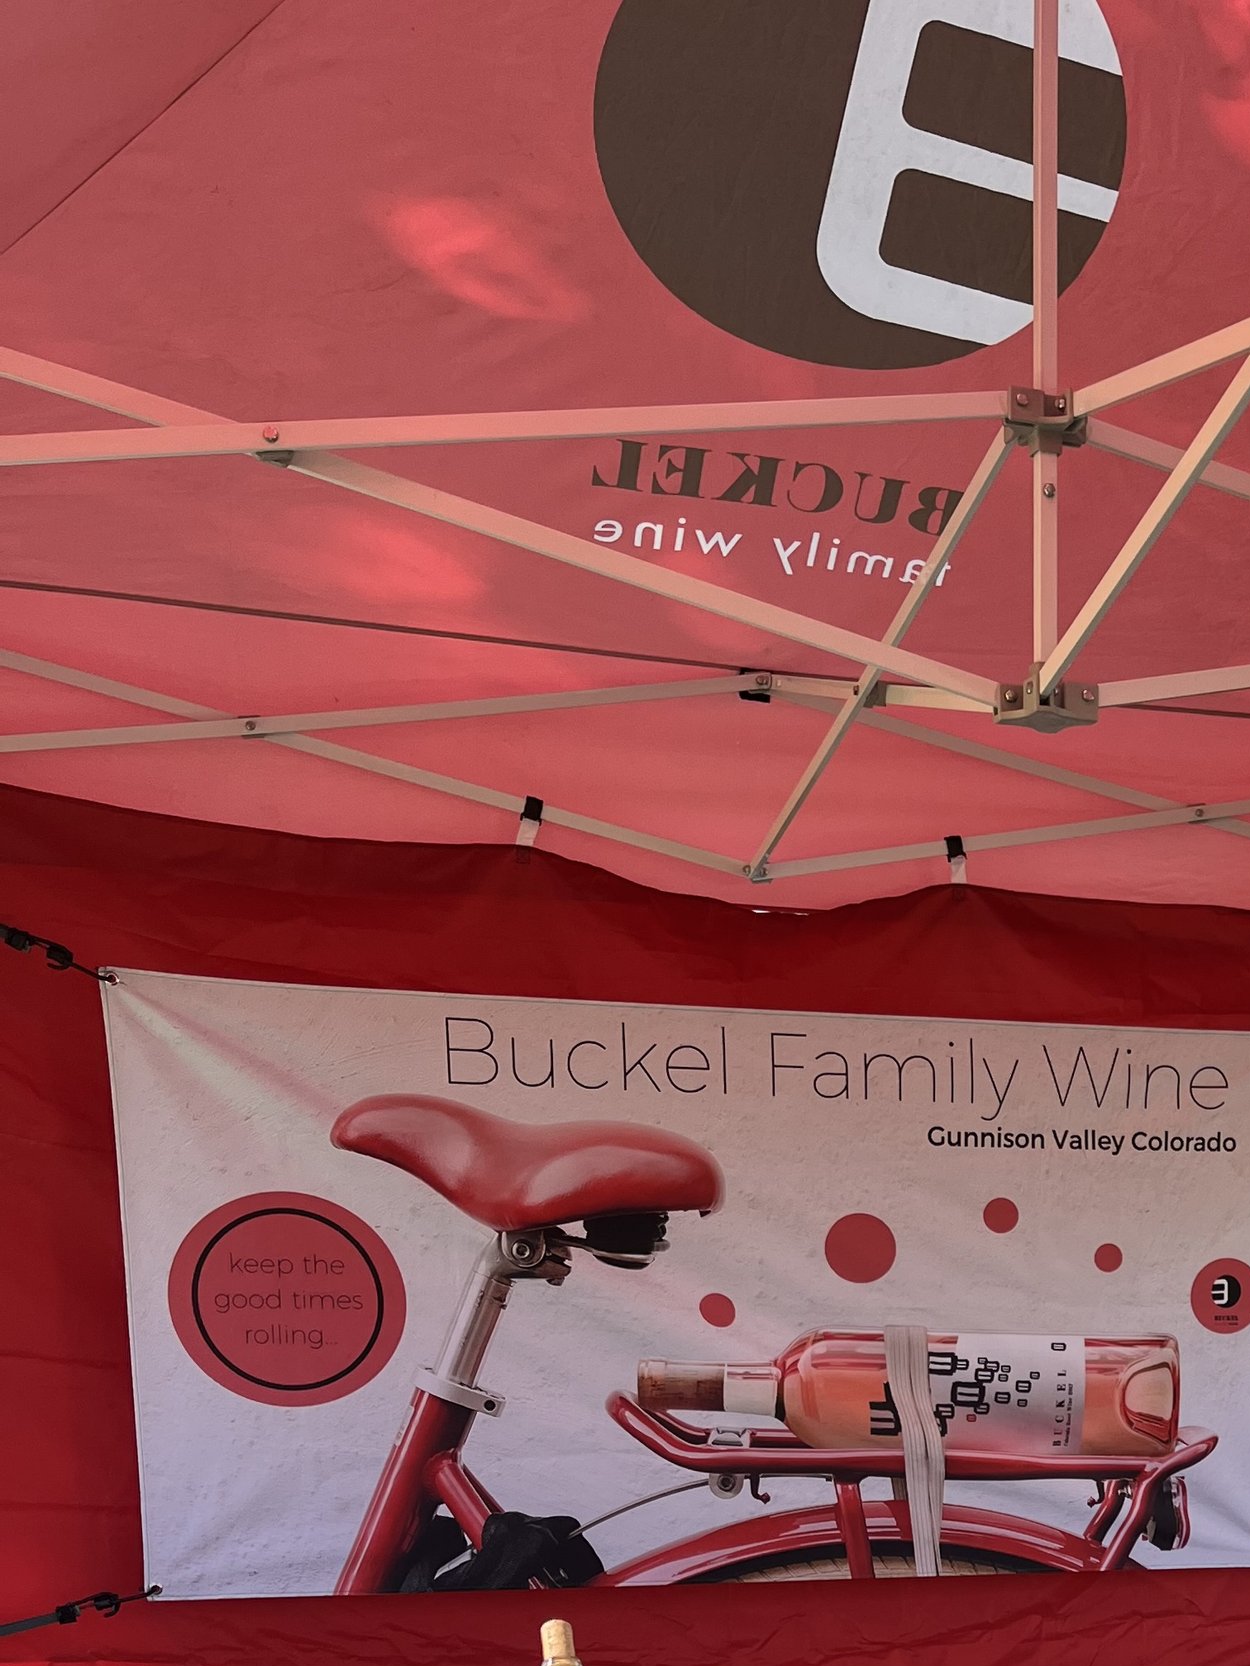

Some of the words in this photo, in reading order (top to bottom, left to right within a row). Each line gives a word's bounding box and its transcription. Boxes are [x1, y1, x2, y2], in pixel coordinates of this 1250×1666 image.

[445, 1016, 728, 1095] Buckel
[770, 1032, 1019, 1121] Family
[1042, 1044, 1229, 1111] Wine
[927, 1126, 1045, 1149] Gunnison
[1051, 1129, 1125, 1155] Valley
[1131, 1130, 1237, 1152] Colorado
[229, 1252, 294, 1278] keep
[303, 1254, 345, 1275] the
[214, 1289, 281, 1314] good
[293, 1292, 363, 1310] times
[245, 1323, 338, 1350] rolling...
